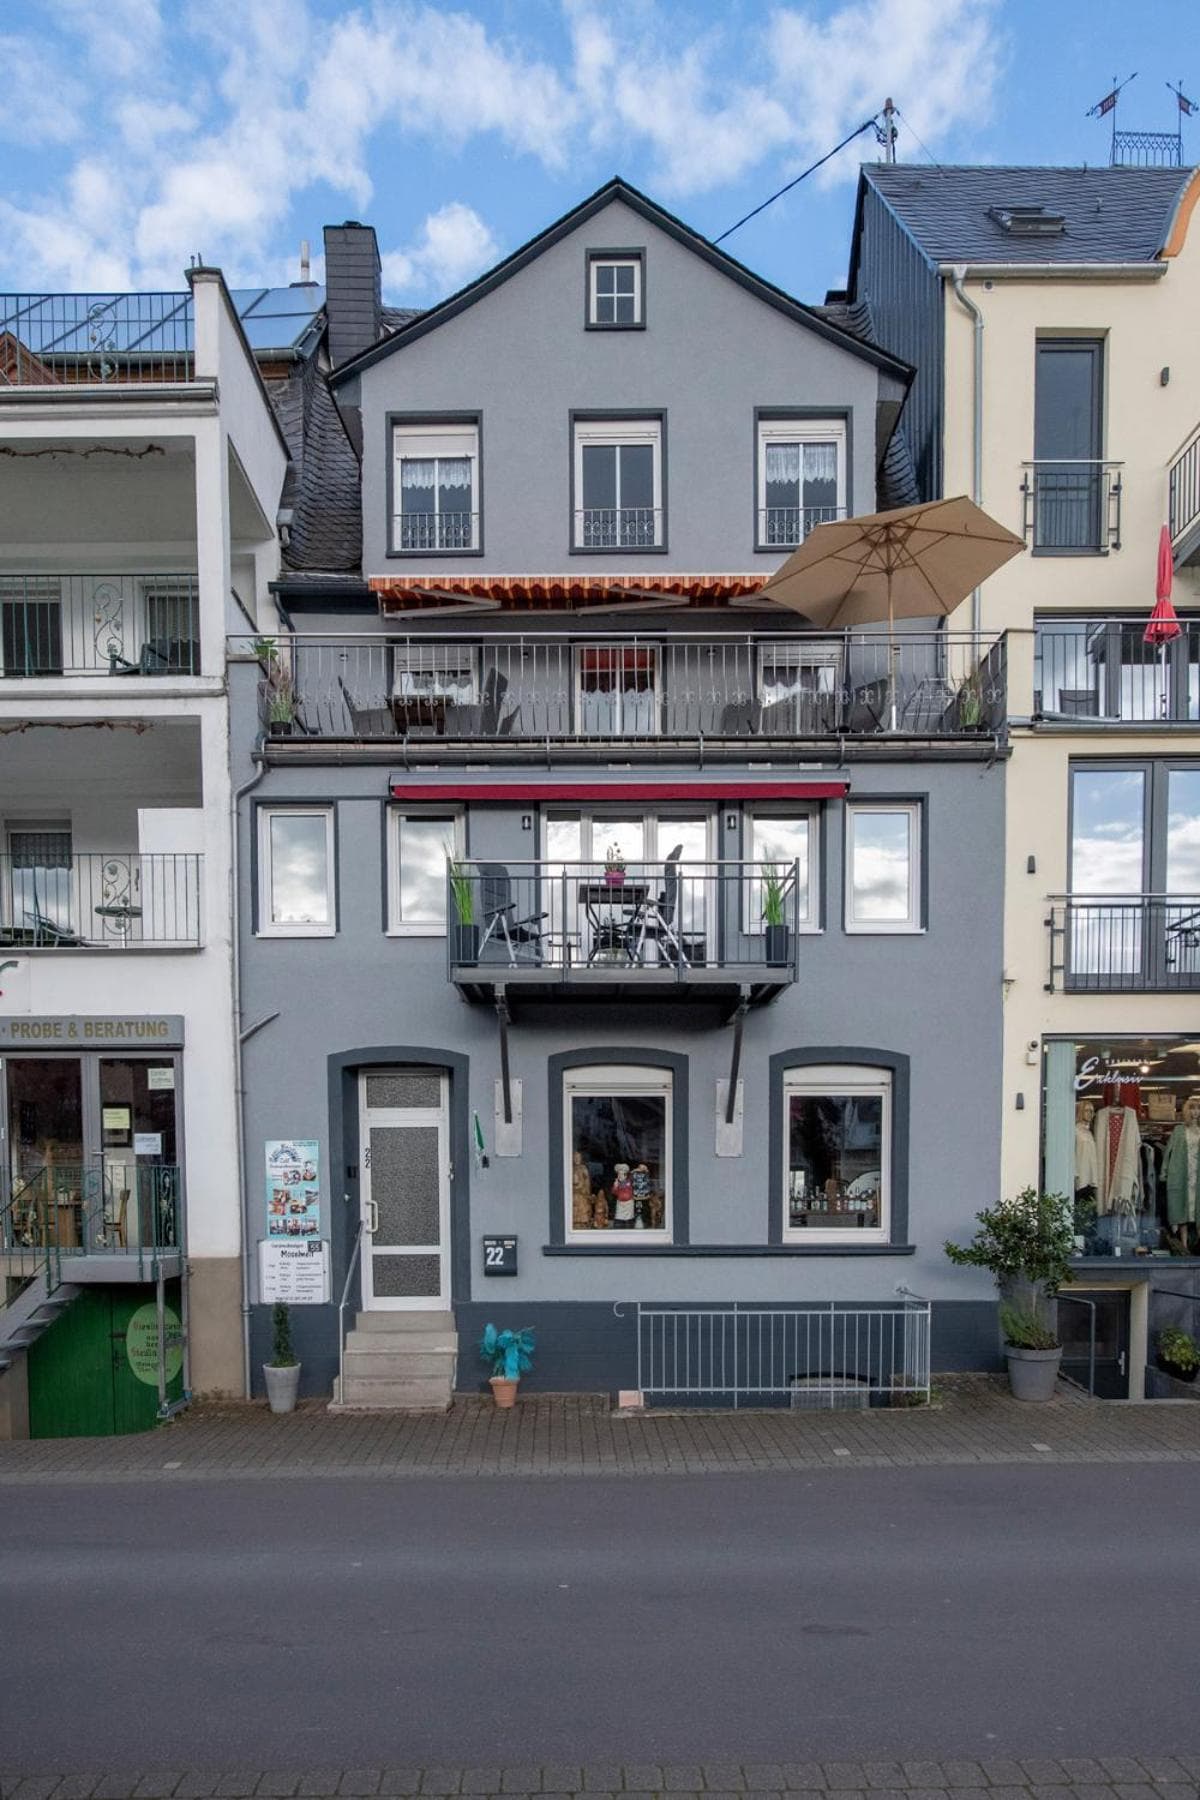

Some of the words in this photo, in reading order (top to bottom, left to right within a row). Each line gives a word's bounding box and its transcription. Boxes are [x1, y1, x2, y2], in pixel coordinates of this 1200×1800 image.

[10, 1022, 62, 1038] PROBE
[68, 1021, 78, 1039] &
[84, 1020, 169, 1038] BERATUNG
[486, 1247, 504, 1265] 22
